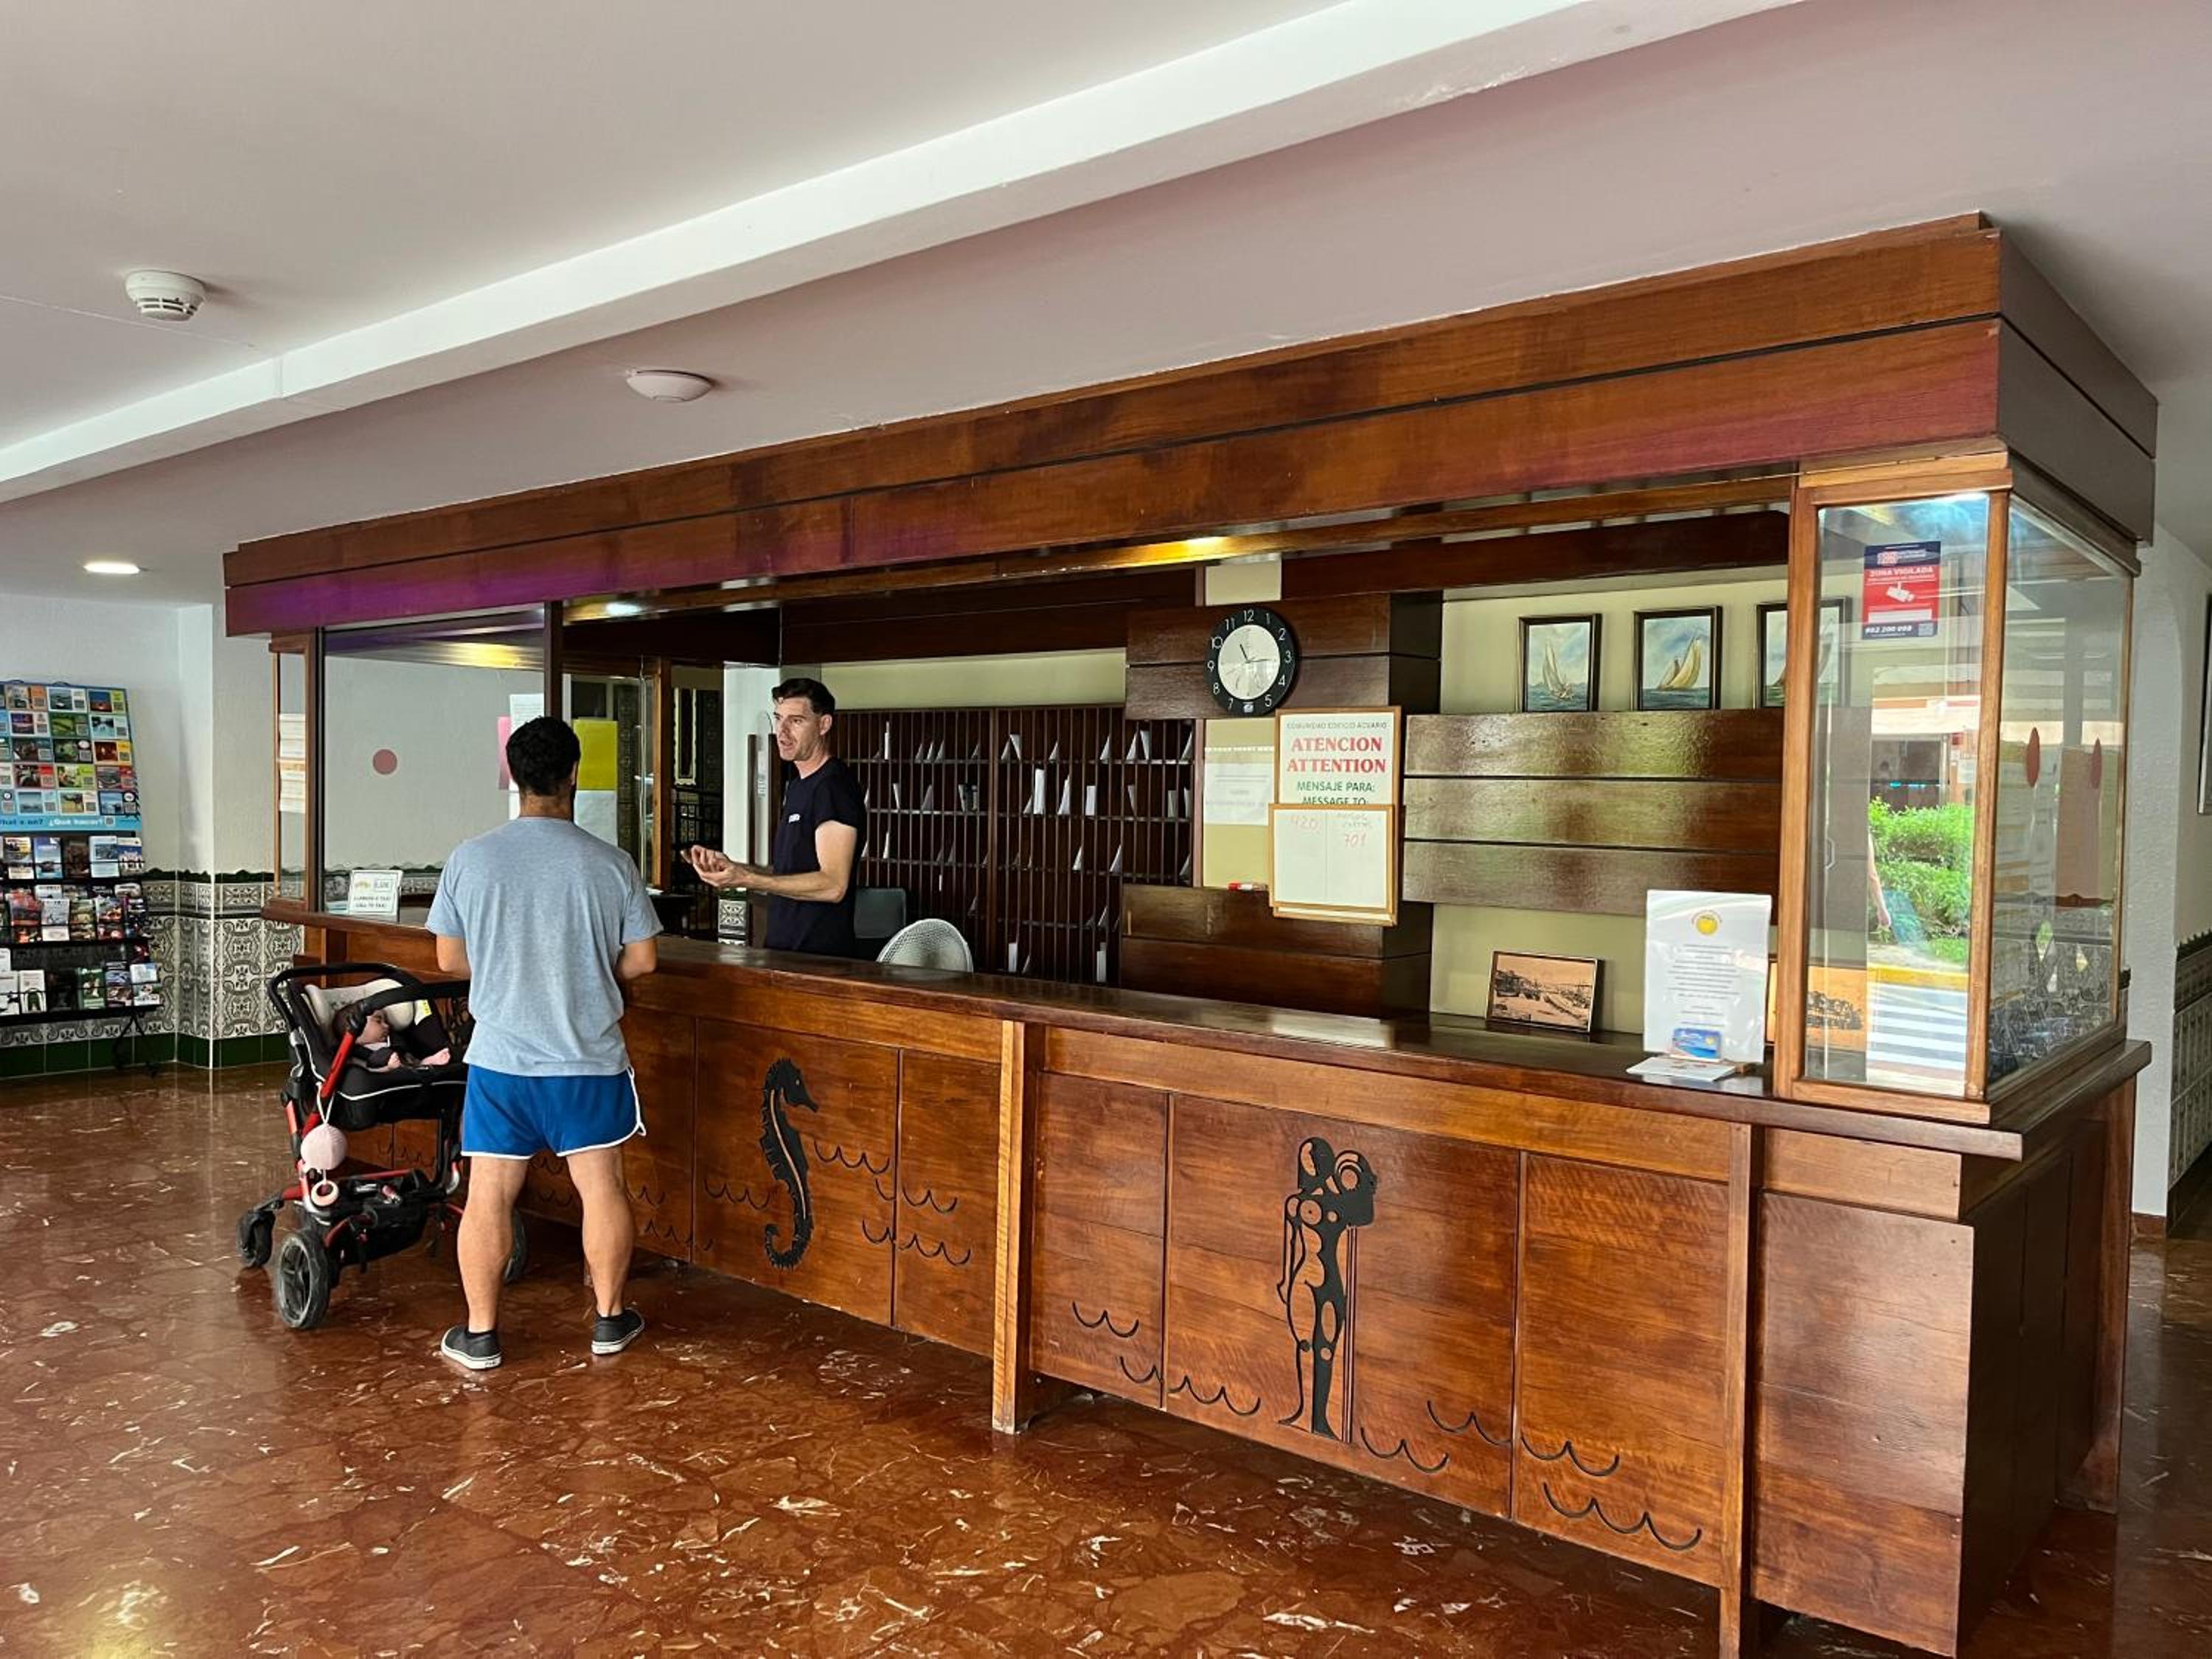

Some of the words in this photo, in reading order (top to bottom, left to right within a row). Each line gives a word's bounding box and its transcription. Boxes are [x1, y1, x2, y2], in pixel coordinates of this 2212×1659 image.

[1243, 609, 1253, 622] 12
[1266, 613, 1270, 625] 1
[1225, 617, 1236, 630] 11
[1279, 627, 1287, 641] 2
[1211, 636, 1223, 649] 10
[1284, 650, 1293, 664] 3
[1207, 660, 1215, 672] 9
[1278, 674, 1286, 686] 4
[1213, 682, 1220, 695] 8
[1228, 698, 1234, 710] 7
[1265, 694, 1272, 707] 5
[1292, 737, 1382, 752] ATENCION
[1287, 758, 1386, 773] ATTENTION
[1297, 781, 1343, 791] MENSAJE
